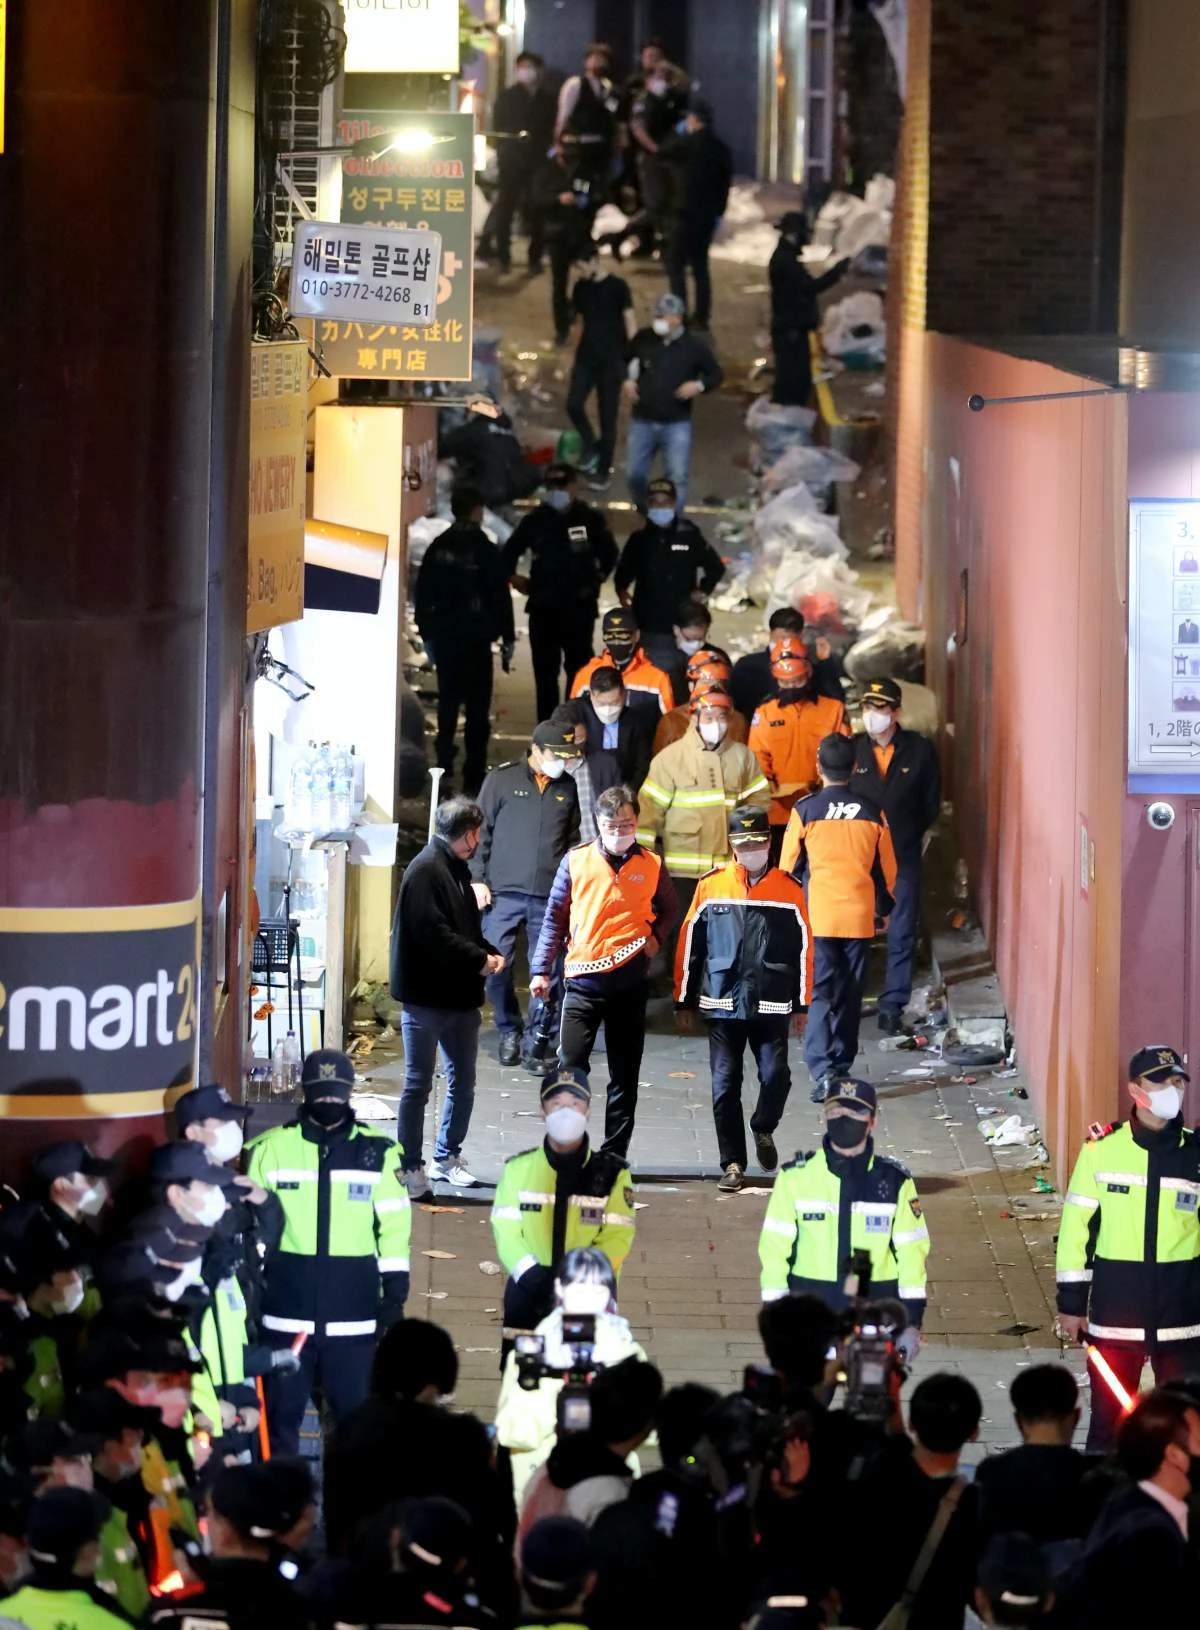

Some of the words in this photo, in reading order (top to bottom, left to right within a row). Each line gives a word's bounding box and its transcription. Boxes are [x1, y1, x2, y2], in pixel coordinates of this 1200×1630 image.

[339, 187, 465, 212] 성구두전문
[304, 238, 361, 275] 해밀톤
[371, 244, 431, 282] 골프샵
[301, 279, 411, 303] 010-3772-4268
[413, 303, 429, 316] B1
